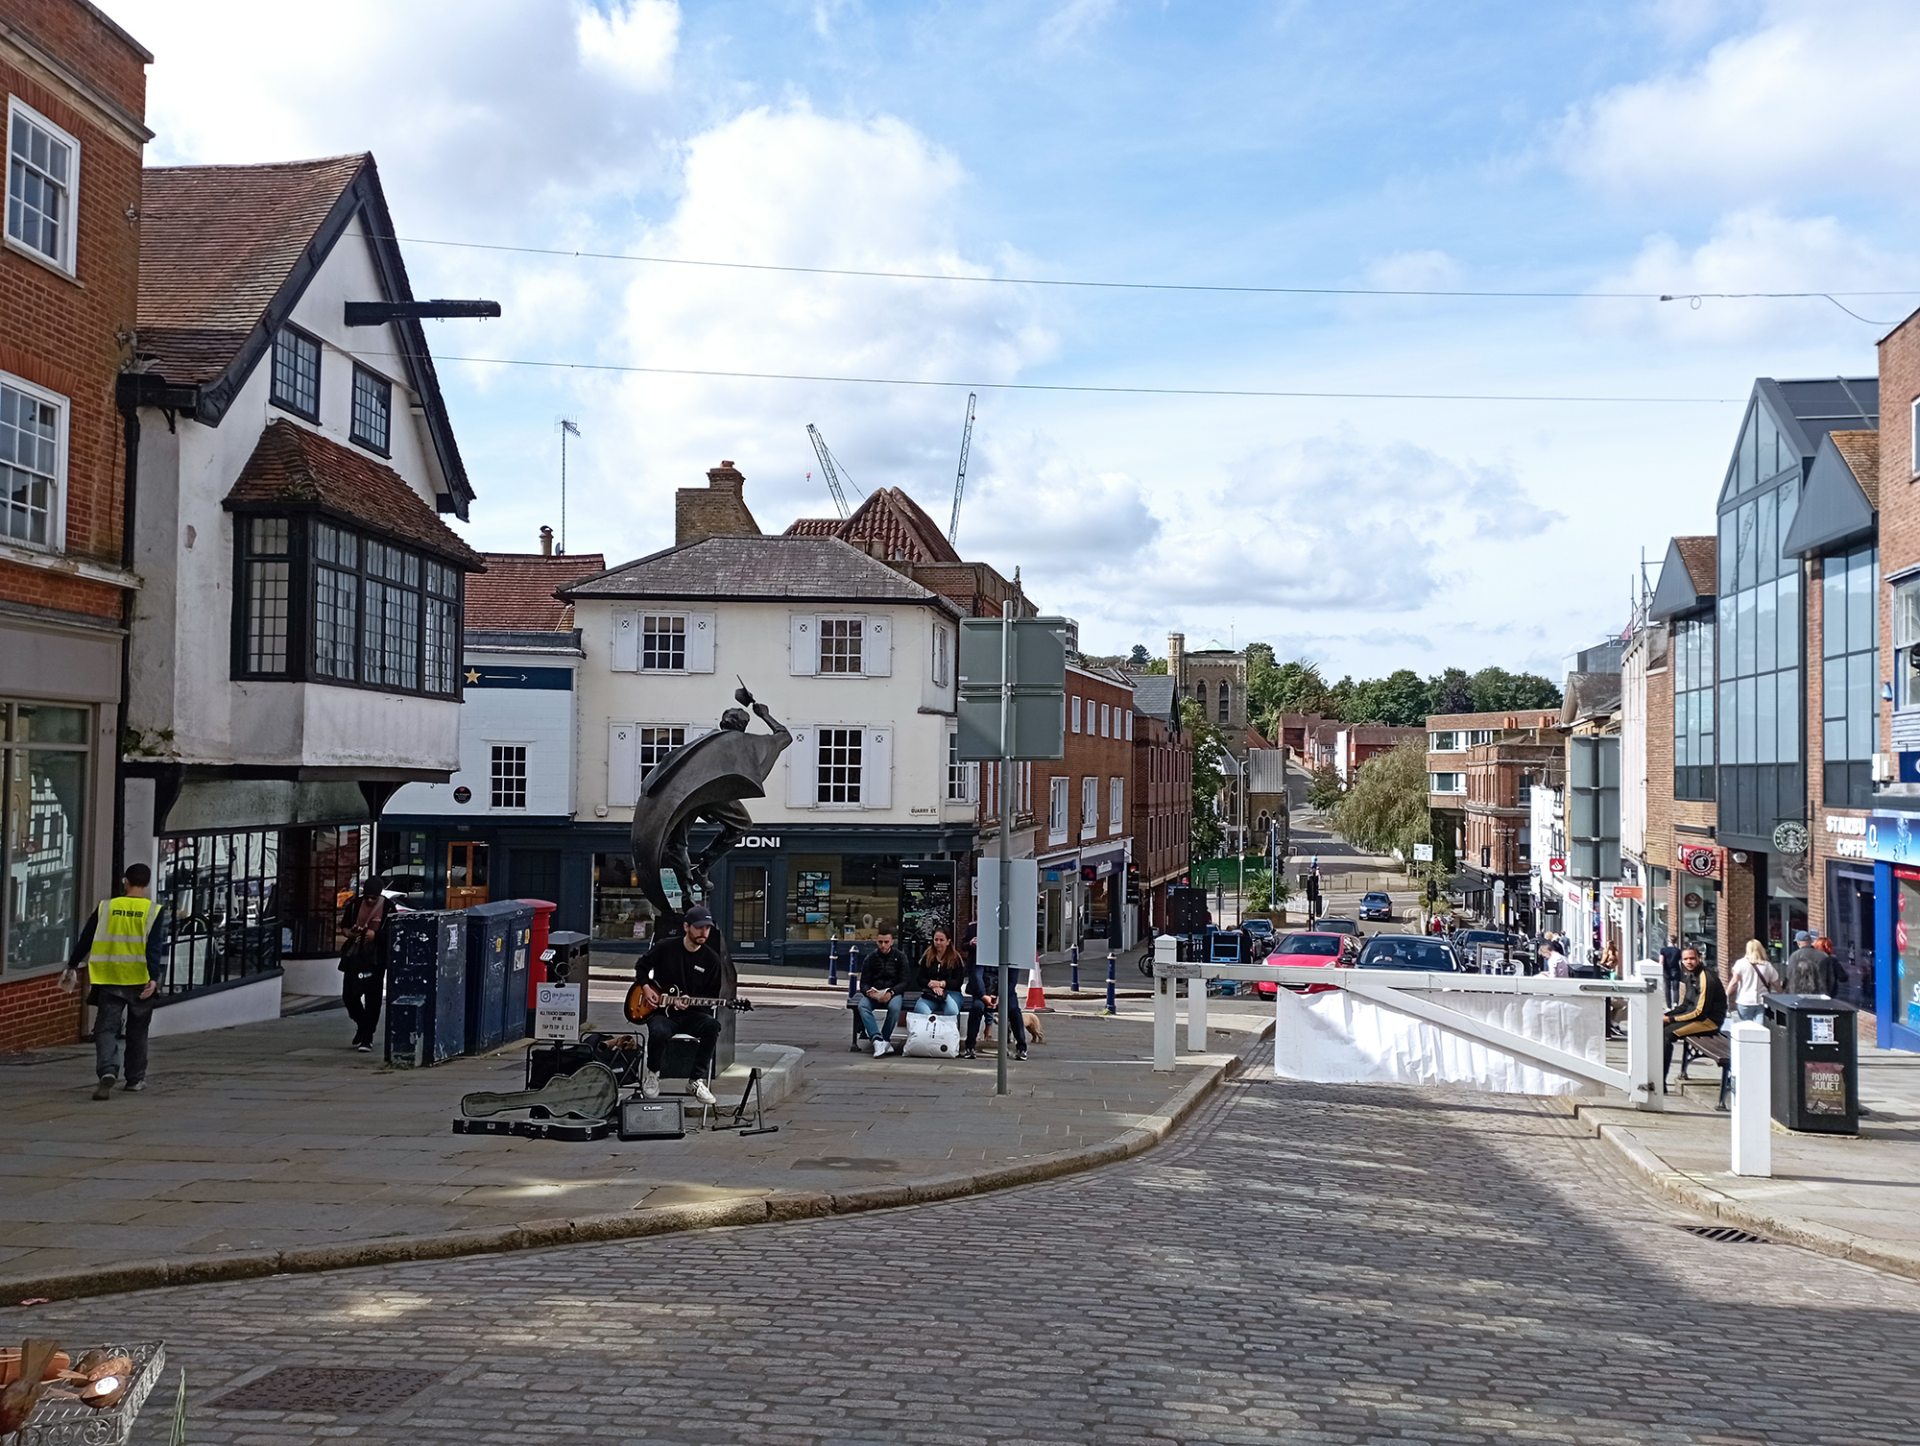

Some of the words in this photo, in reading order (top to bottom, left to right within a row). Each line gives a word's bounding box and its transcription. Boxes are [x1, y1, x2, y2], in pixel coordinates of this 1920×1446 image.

[1826, 815, 1866, 835] STARBU
[1836, 838, 1867, 858] COFFE
[1687, 850, 1715, 861] CHIPOTLE
[1812, 1072, 1840, 1082] ROMEO
[1812, 1081, 1839, 1091] JULIET
